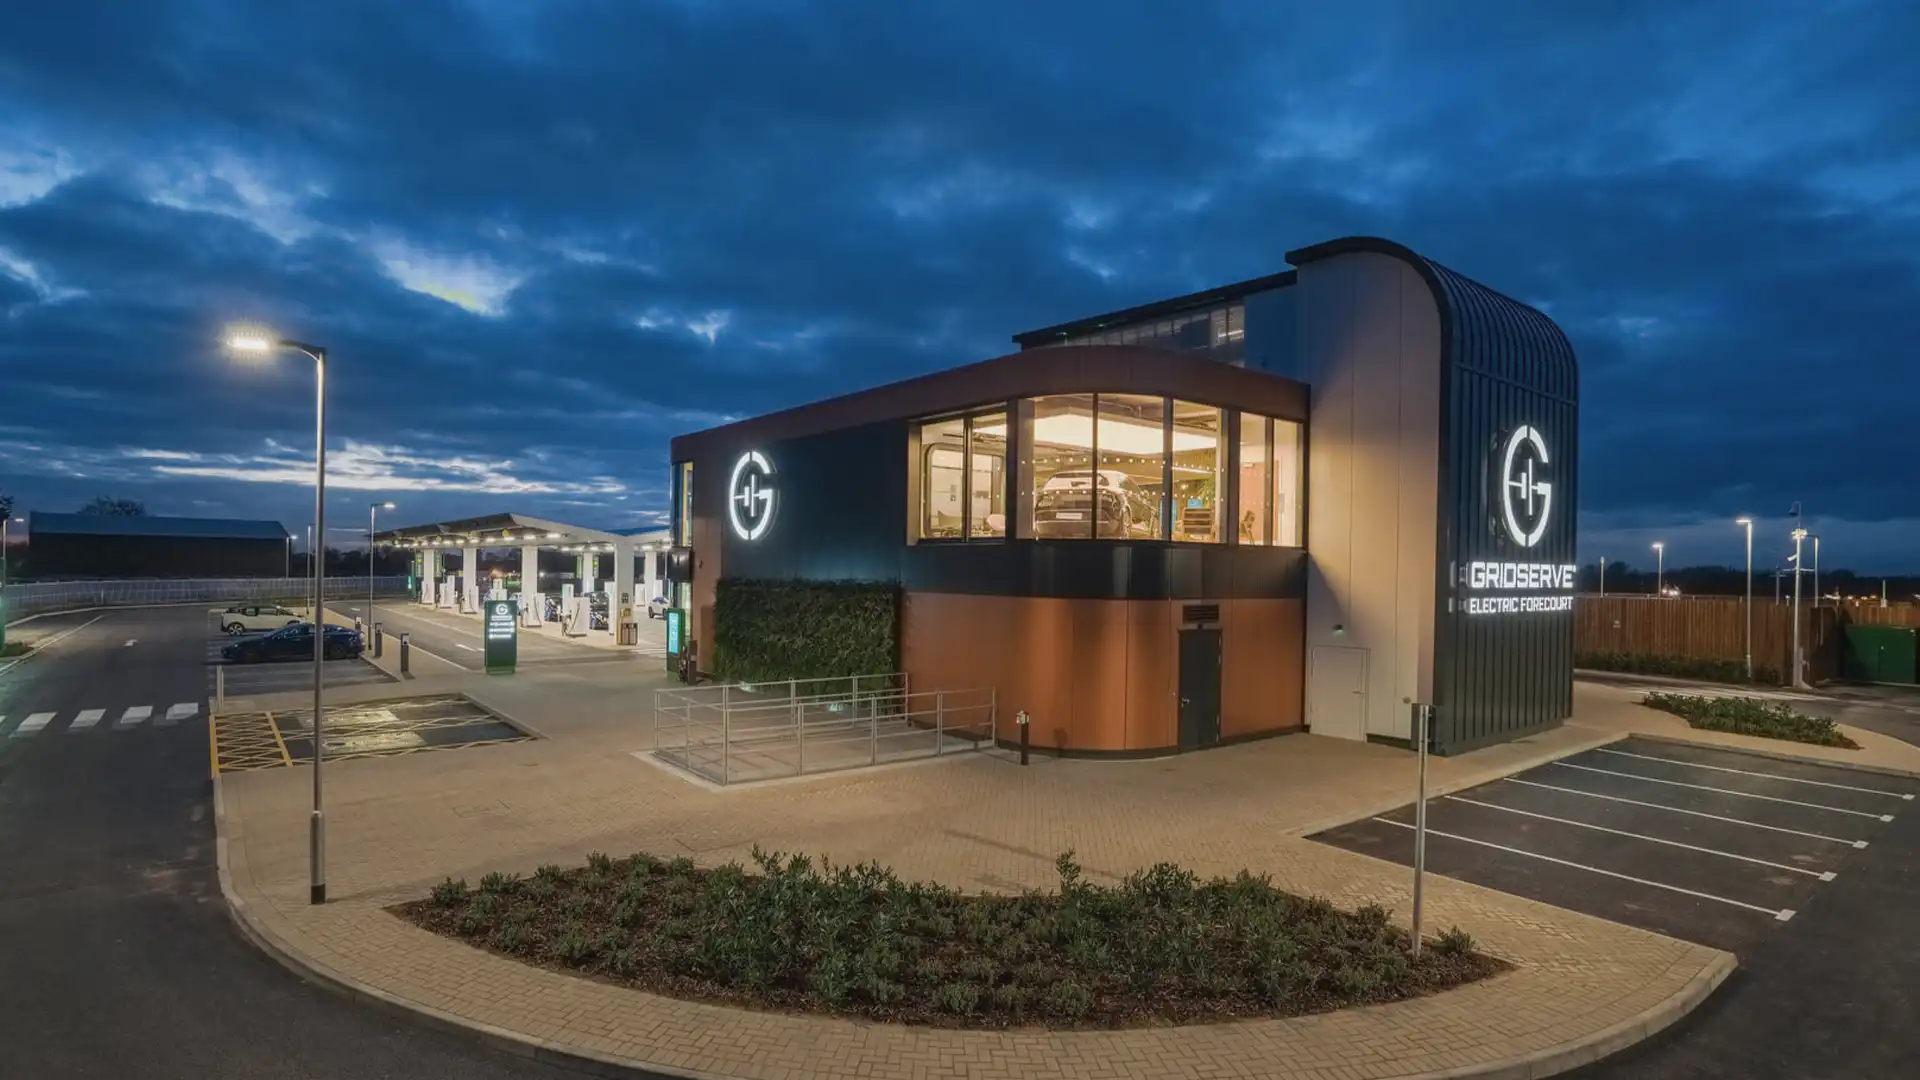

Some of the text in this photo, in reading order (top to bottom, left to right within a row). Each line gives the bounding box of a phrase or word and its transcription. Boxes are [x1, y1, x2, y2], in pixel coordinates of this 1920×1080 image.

[1471, 561, 1574, 589] GRIDSERVE
[1469, 596, 1574, 614] ELECTRIC FORECOURT
